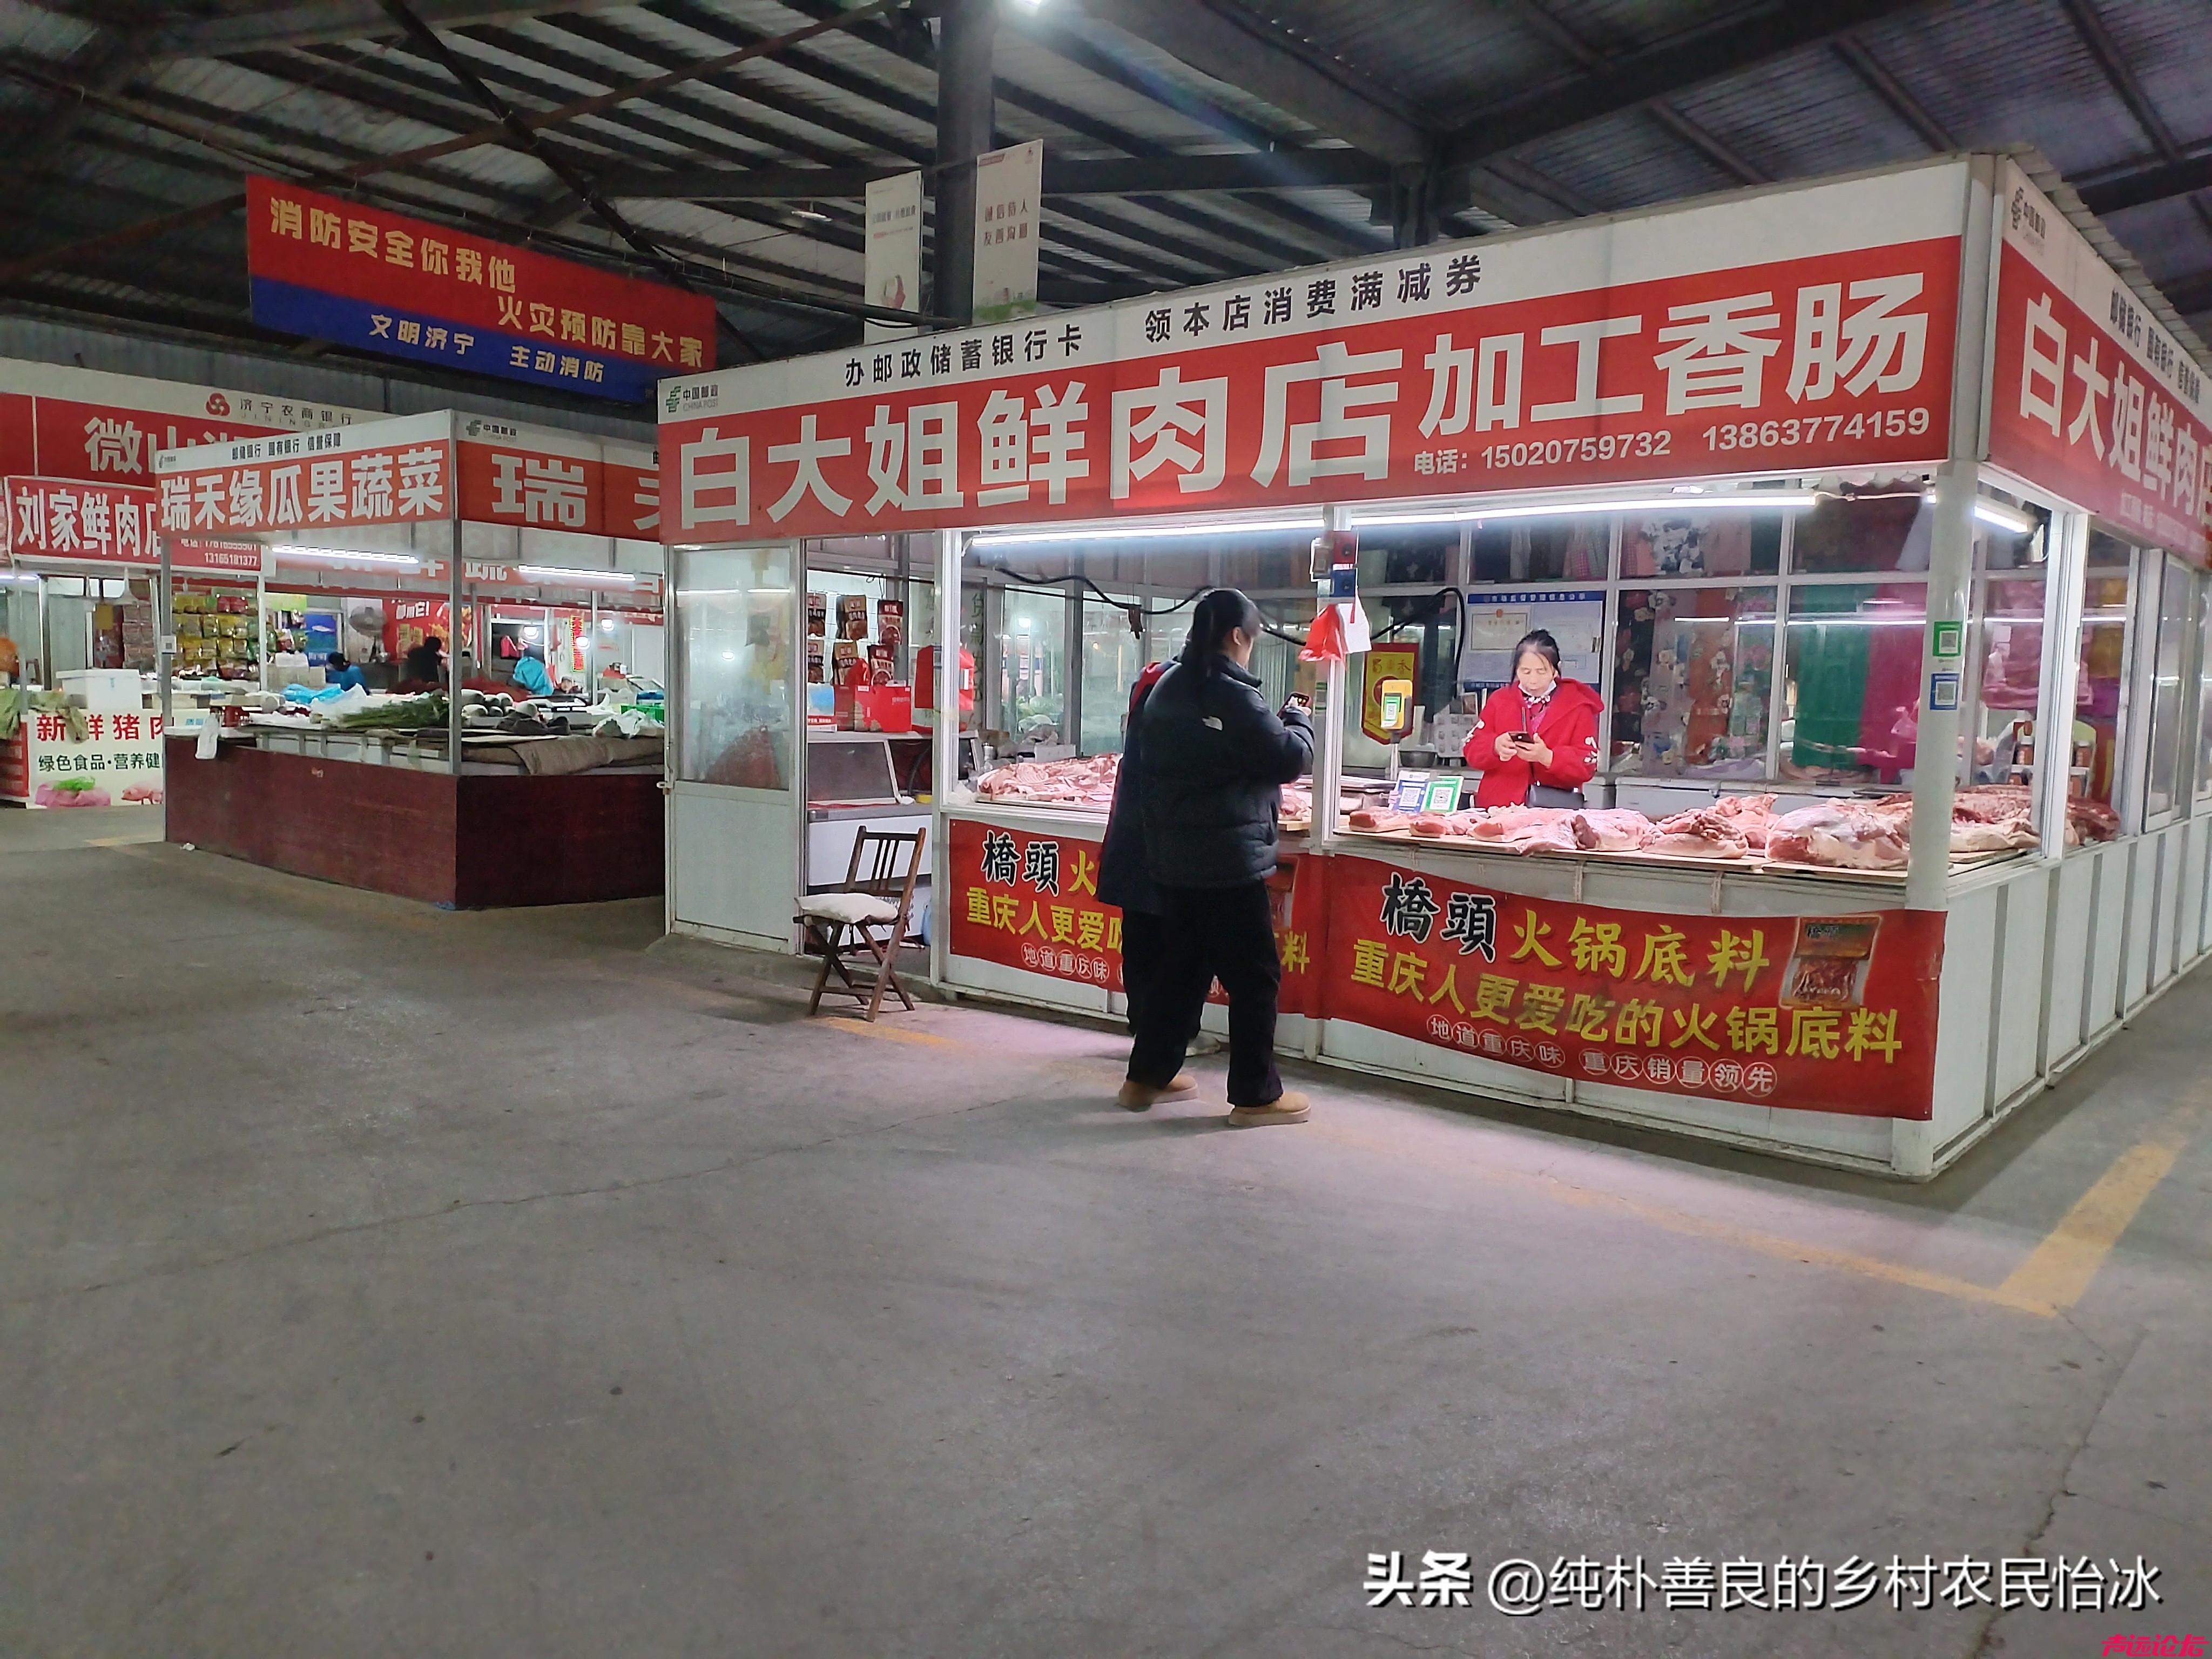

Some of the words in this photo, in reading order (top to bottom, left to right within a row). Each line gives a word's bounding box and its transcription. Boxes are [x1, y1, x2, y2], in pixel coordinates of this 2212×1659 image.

[271, 197, 516, 293] 消防安全你我他
[498, 296, 703, 368] 火灾预防靠大家
[1145, 254, 1481, 342] 领本店消费满减券
[370, 314, 474, 355] 文明济宁
[509, 346, 604, 383] 主动消防
[845, 324, 1082, 387] 办邮政储蓄银行卡
[241, 398, 351, 425] 济宁农商银行
[680, 341, 1403, 530] 白大姐鲜肉店
[1419, 273, 1928, 439] 加工香肠
[683, 385, 718, 401] 中国邮政
[1702, 407, 1929, 451] 13863774159
[161, 447, 443, 531] 瑞禾缘瓜果蔬菜
[981, 830, 1060, 896] 橋頭
[1022, 943, 1109, 982] 地道重庆味
[1380, 872, 1496, 963] 橋頭
[1509, 909, 1769, 993] 火锅底料
[1351, 939, 1902, 1063] 重庆人更爱吃的火锅底料
[1427, 1015, 1564, 1068] 地道重庆味
[1580, 1049, 1776, 1097] 重庆销量领先
